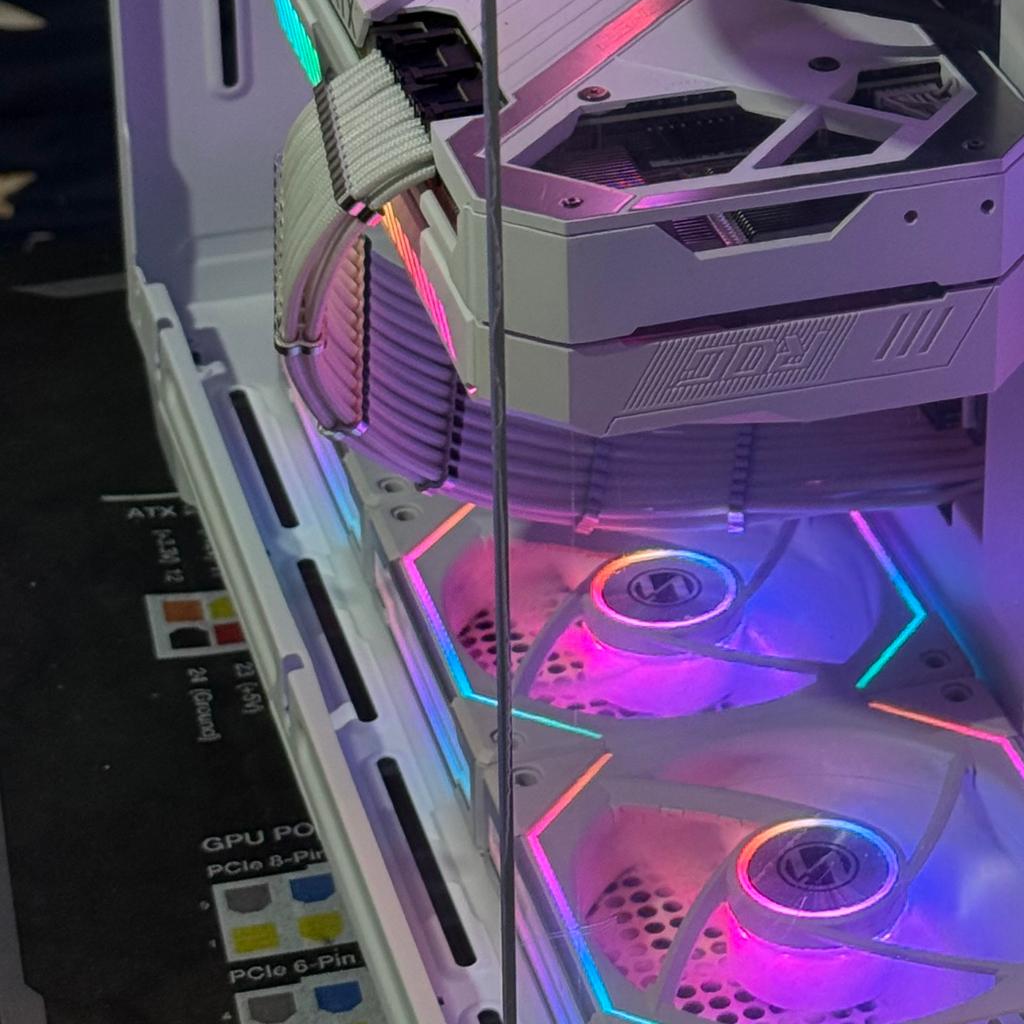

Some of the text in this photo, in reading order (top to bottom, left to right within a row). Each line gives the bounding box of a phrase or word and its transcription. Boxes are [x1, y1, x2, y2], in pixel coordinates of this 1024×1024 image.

[127, 505, 178, 520] ATX
[201, 821, 316, 852] GPU PO
[206, 860, 264, 878] PCIe
[228, 948, 357, 984] PCIe 6-Pin
